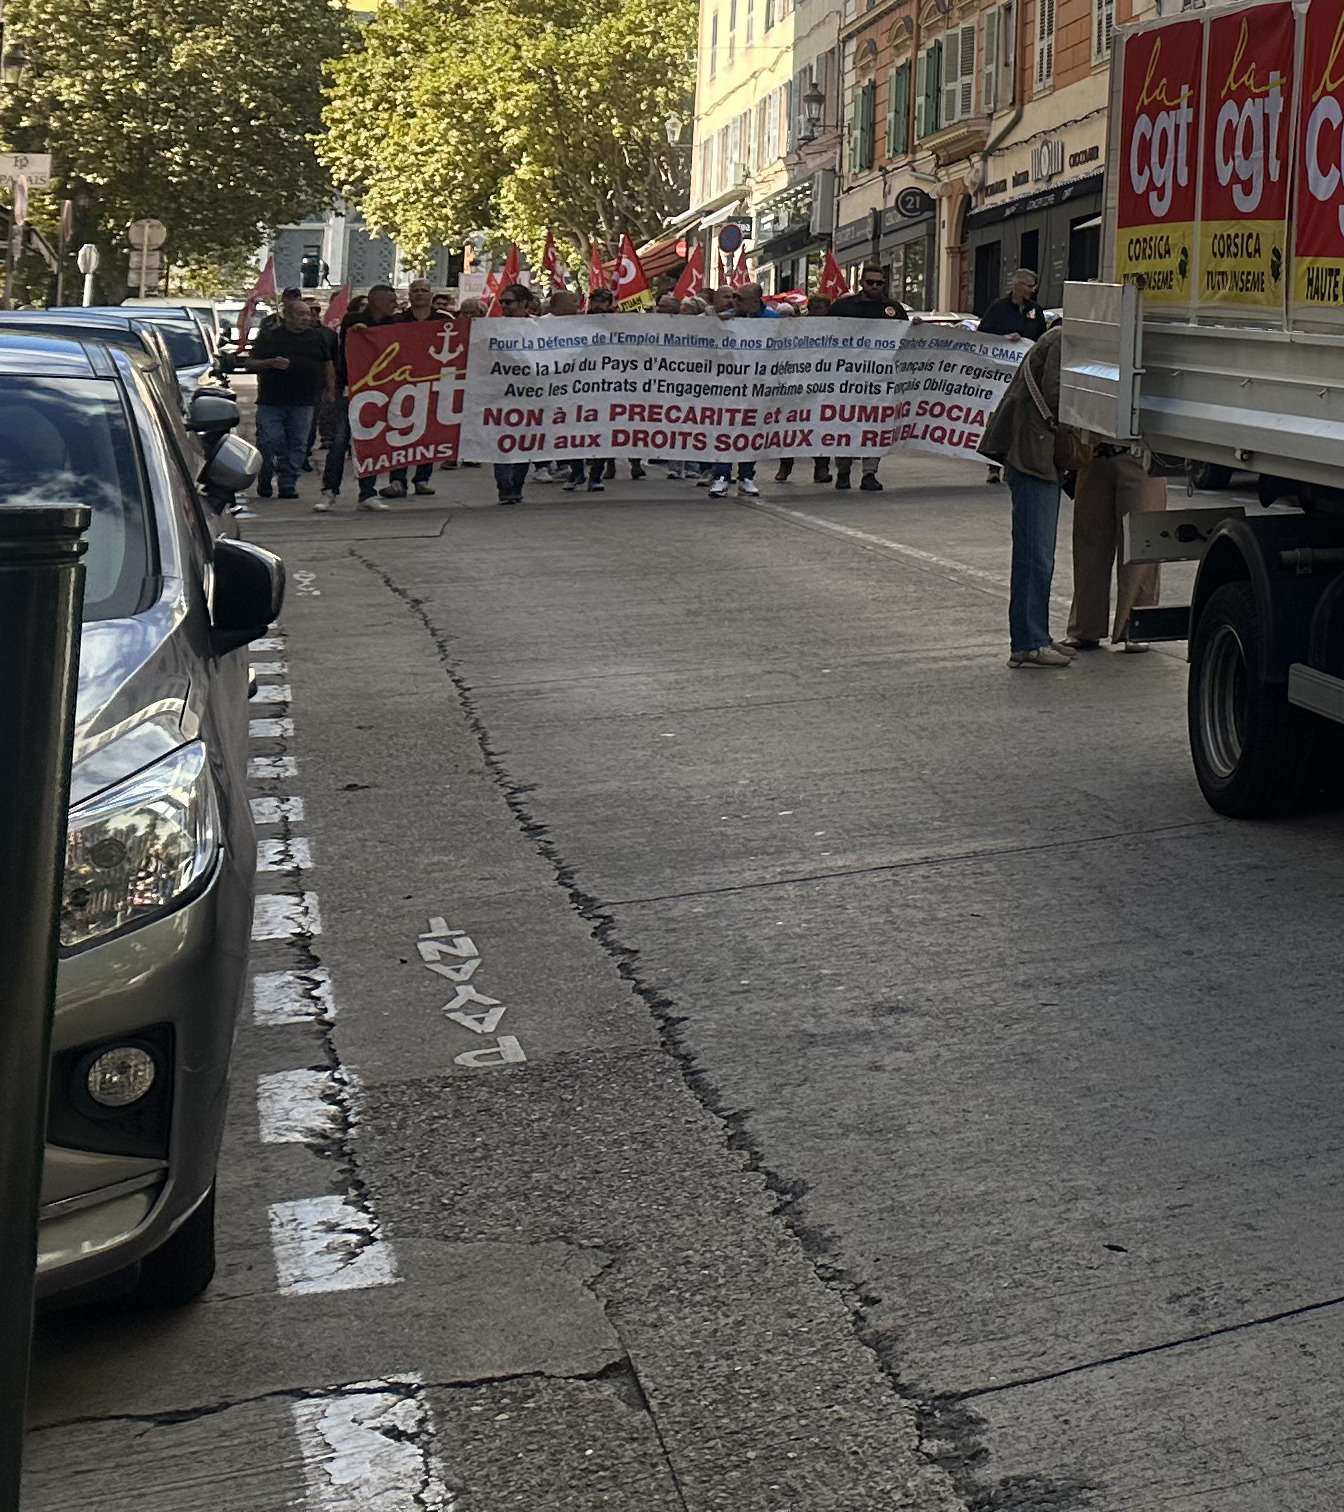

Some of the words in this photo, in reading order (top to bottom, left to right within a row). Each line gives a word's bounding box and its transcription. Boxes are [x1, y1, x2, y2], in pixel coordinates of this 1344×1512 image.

[1221, 17, 1287, 99] la
[1136, 36, 1193, 114] la
[1130, 84, 1193, 218] cgt
[1215, 70, 1285, 213] cgt
[0, 175, 47, 185] PAAIS
[905, 196, 920, 208] 21
[1127, 235, 1171, 262] CORSICA
[1212, 232, 1261, 259] CORSICA
[1305, 266, 1339, 301] HAUTE
[489, 337, 517, 350] Pour
[522, 338, 534, 349] La
[537, 335, 588, 349] Défense
[592, 332, 606, 344] de
[609, 332, 660, 346] l'Emploi
[722, 337, 736, 348] de
[740, 338, 762, 349] nos
[765, 336, 792, 350] Droits
[842, 336, 853, 348] et
[856, 337, 872, 348] de
[875, 340, 896, 349] nos
[351, 342, 467, 392] la
[490, 361, 531, 376] Avec
[536, 362, 549, 376] la
[554, 359, 575, 375] Loi
[578, 357, 596, 372] du
[602, 356, 639, 373] Pays
[644, 357, 712, 373] d'Accueil
[717, 363, 750, 377] pour
[755, 361, 767, 376] la
[771, 361, 811, 376] défense
[815, 359, 831, 373] du
[836, 359, 893, 375] Pavillon
[938, 359, 956, 373] 1er
[960, 363, 1013, 385] registre
[504, 383, 544, 398] Avec
[548, 383, 568, 397] les
[572, 379, 638, 394] Contrats
[642, 379, 748, 398] d'Engagement
[751, 383, 803, 397] Maritime
[806, 382, 835, 395] sous
[839, 380, 882, 395] droits
[923, 378, 993, 400] Obligatoire
[348, 367, 467, 447] cgt
[483, 407, 544, 427] NON
[552, 406, 567, 425] à
[576, 405, 599, 423] la
[609, 403, 758, 427] PRECARITE
[763, 408, 782, 425] et
[785, 408, 811, 423] au
[497, 433, 546, 454] OUI
[553, 433, 601, 449] aux
[611, 429, 707, 451] DROITS
[714, 429, 814, 452] SOCIAUX
[821, 433, 851, 447] en
[860, 423, 981, 450] REBLIQUE
[353, 443, 453, 474] MARINS
[416, 916, 527, 1067] PAYANT
